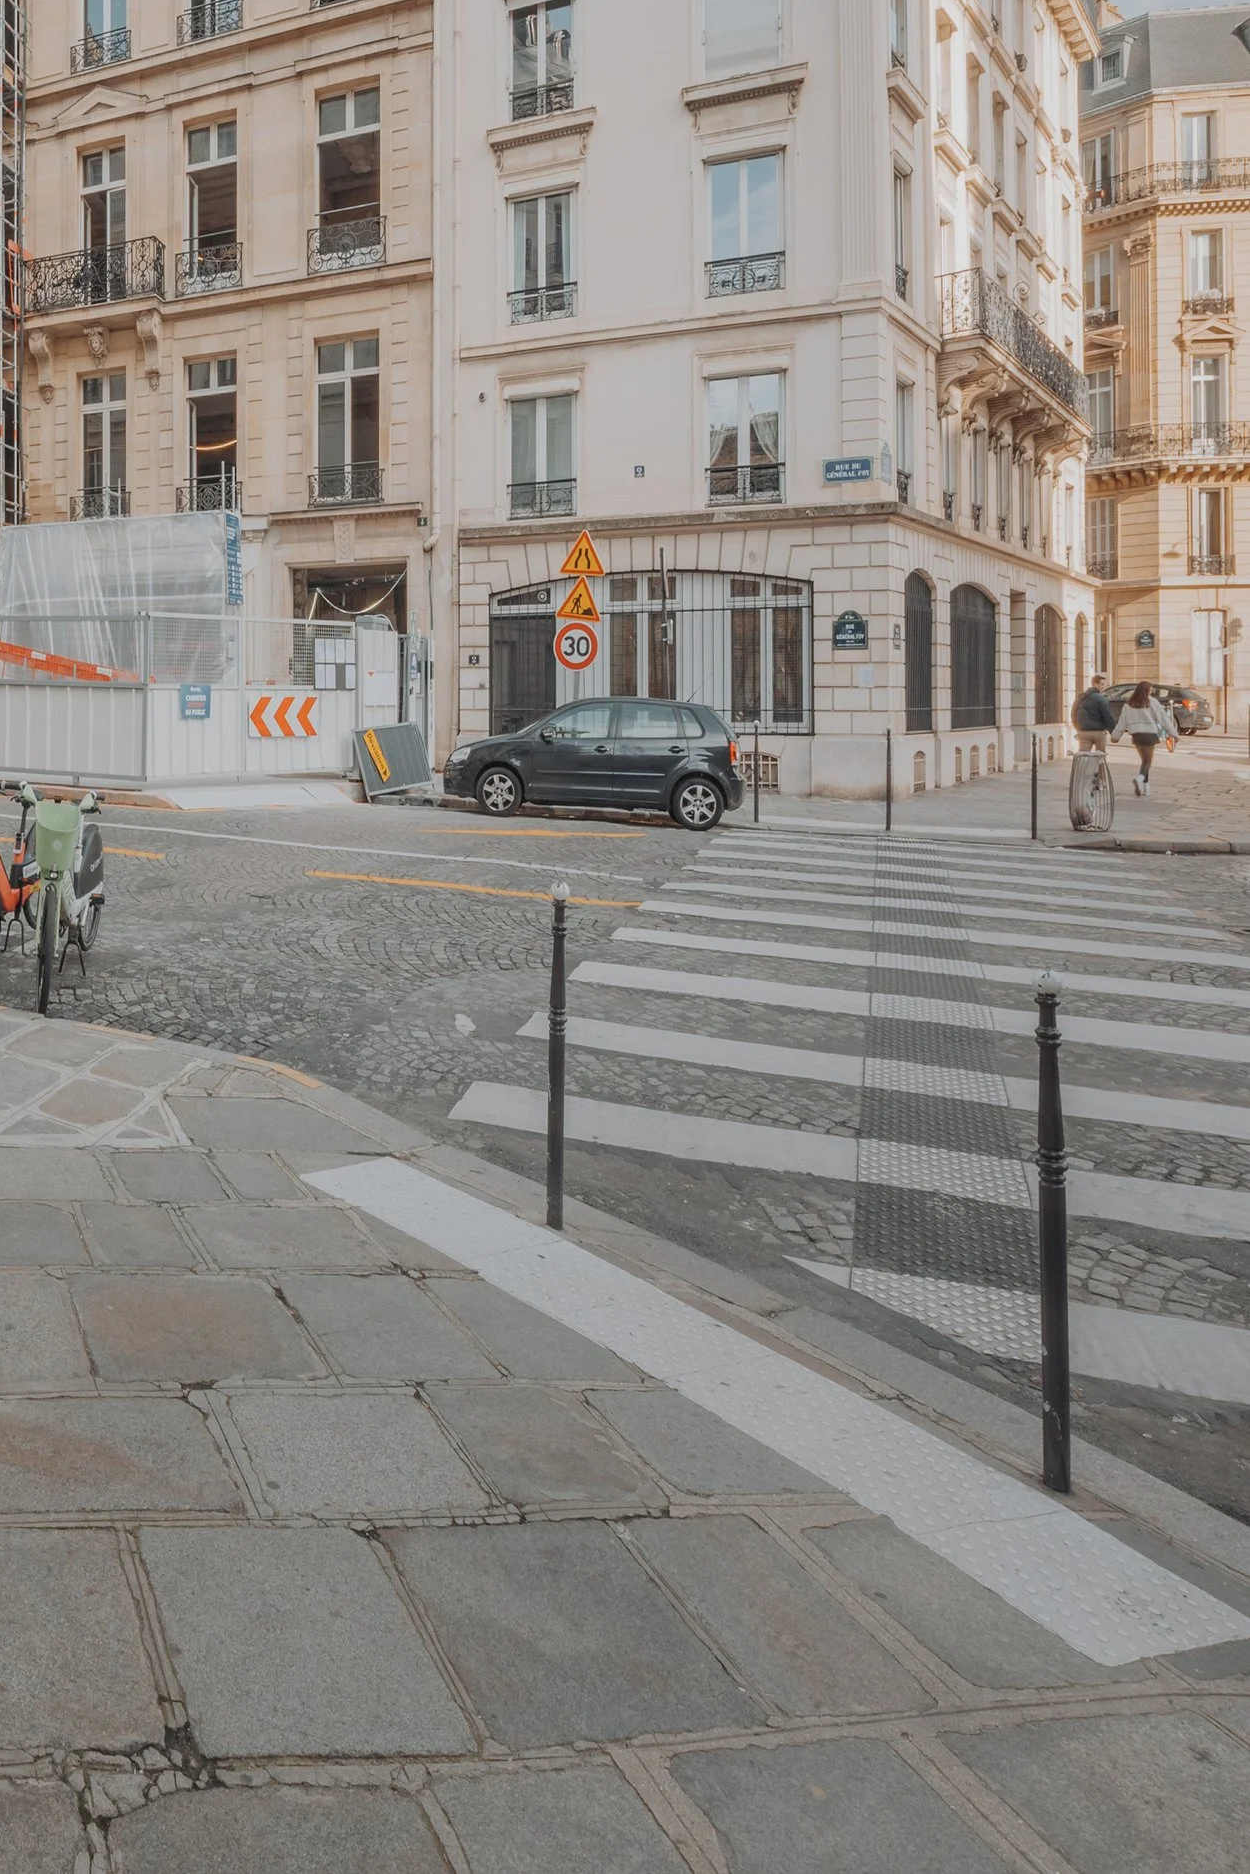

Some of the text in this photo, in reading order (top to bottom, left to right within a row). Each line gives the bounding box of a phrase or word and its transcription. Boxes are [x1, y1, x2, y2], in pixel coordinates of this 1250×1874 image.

[826, 469, 870, 479] GÉNÉRAL FOY
[563, 636, 590, 656] 30
